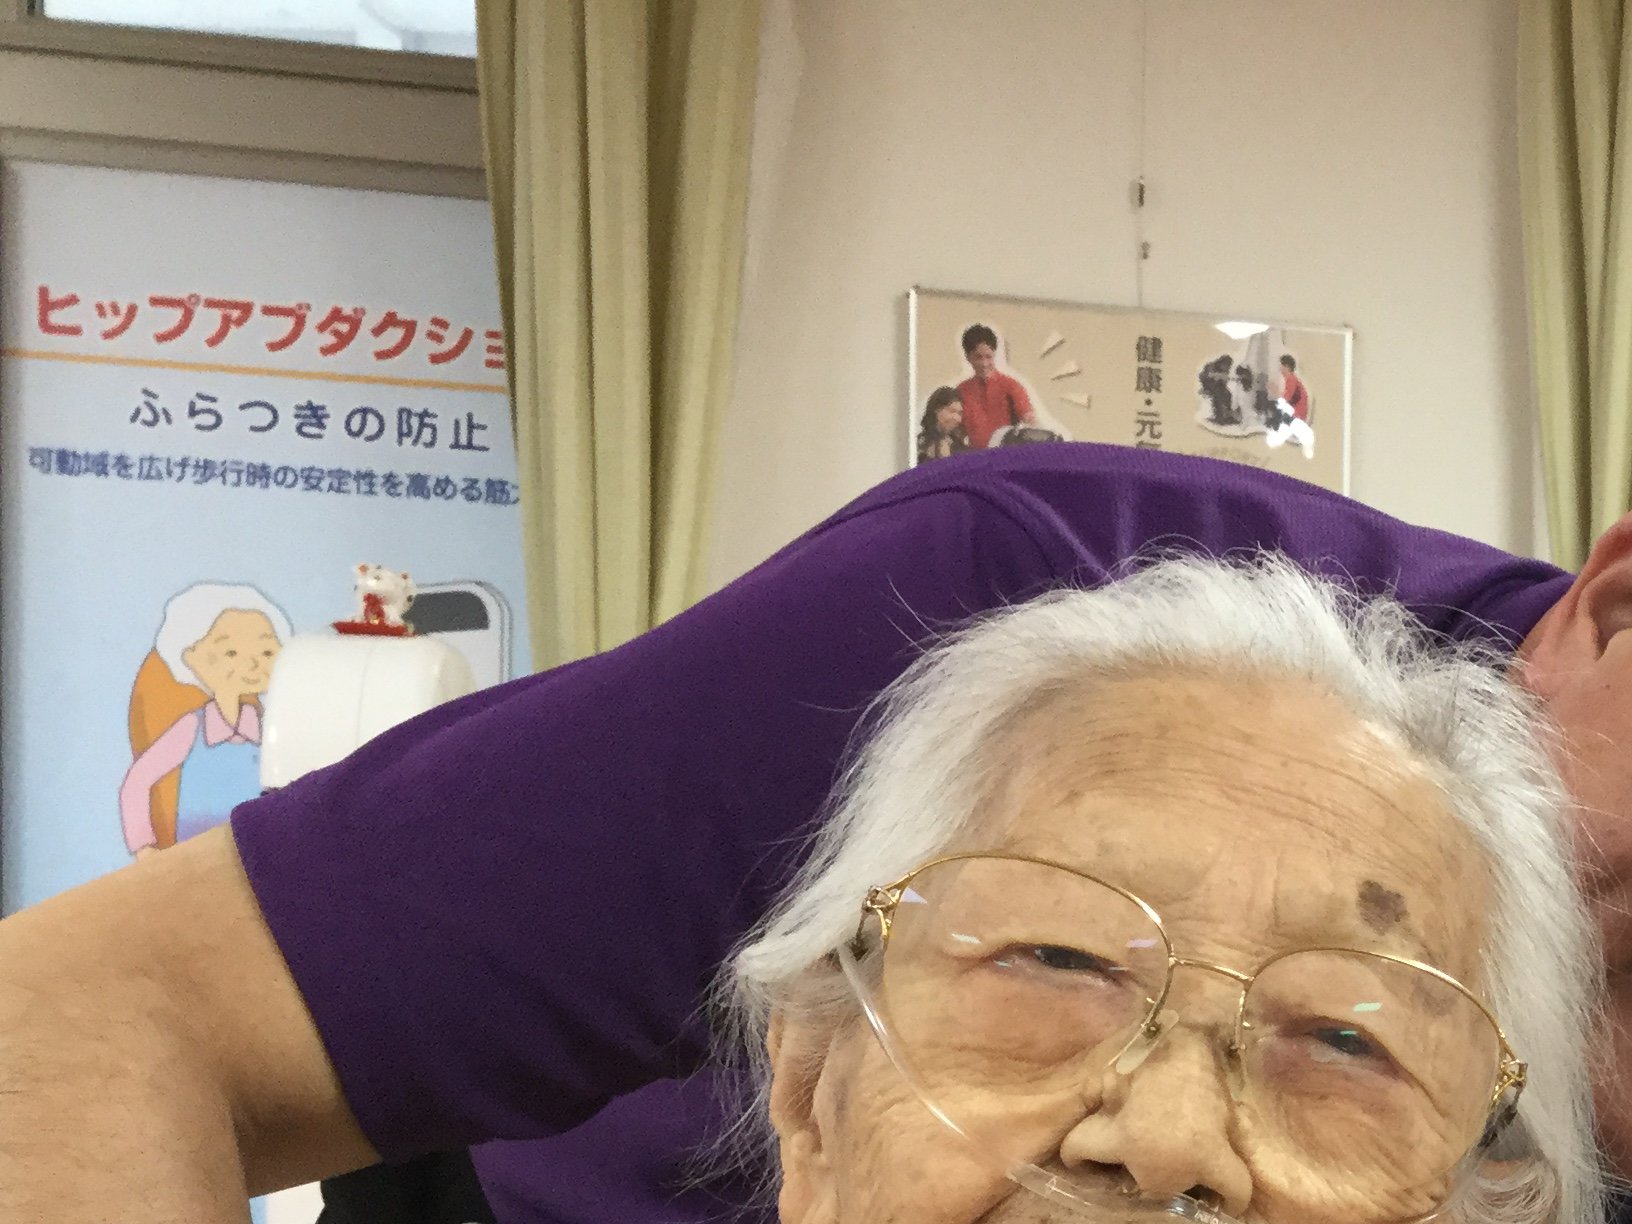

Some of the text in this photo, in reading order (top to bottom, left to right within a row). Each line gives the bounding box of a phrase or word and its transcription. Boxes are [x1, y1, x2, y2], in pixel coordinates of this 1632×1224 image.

[129, 387, 490, 452] ふらつきの防止
[1134, 335, 1163, 449] 健康・元
[27, 446, 520, 506] 可動域を広げ歩行時の安定性を高める筋
